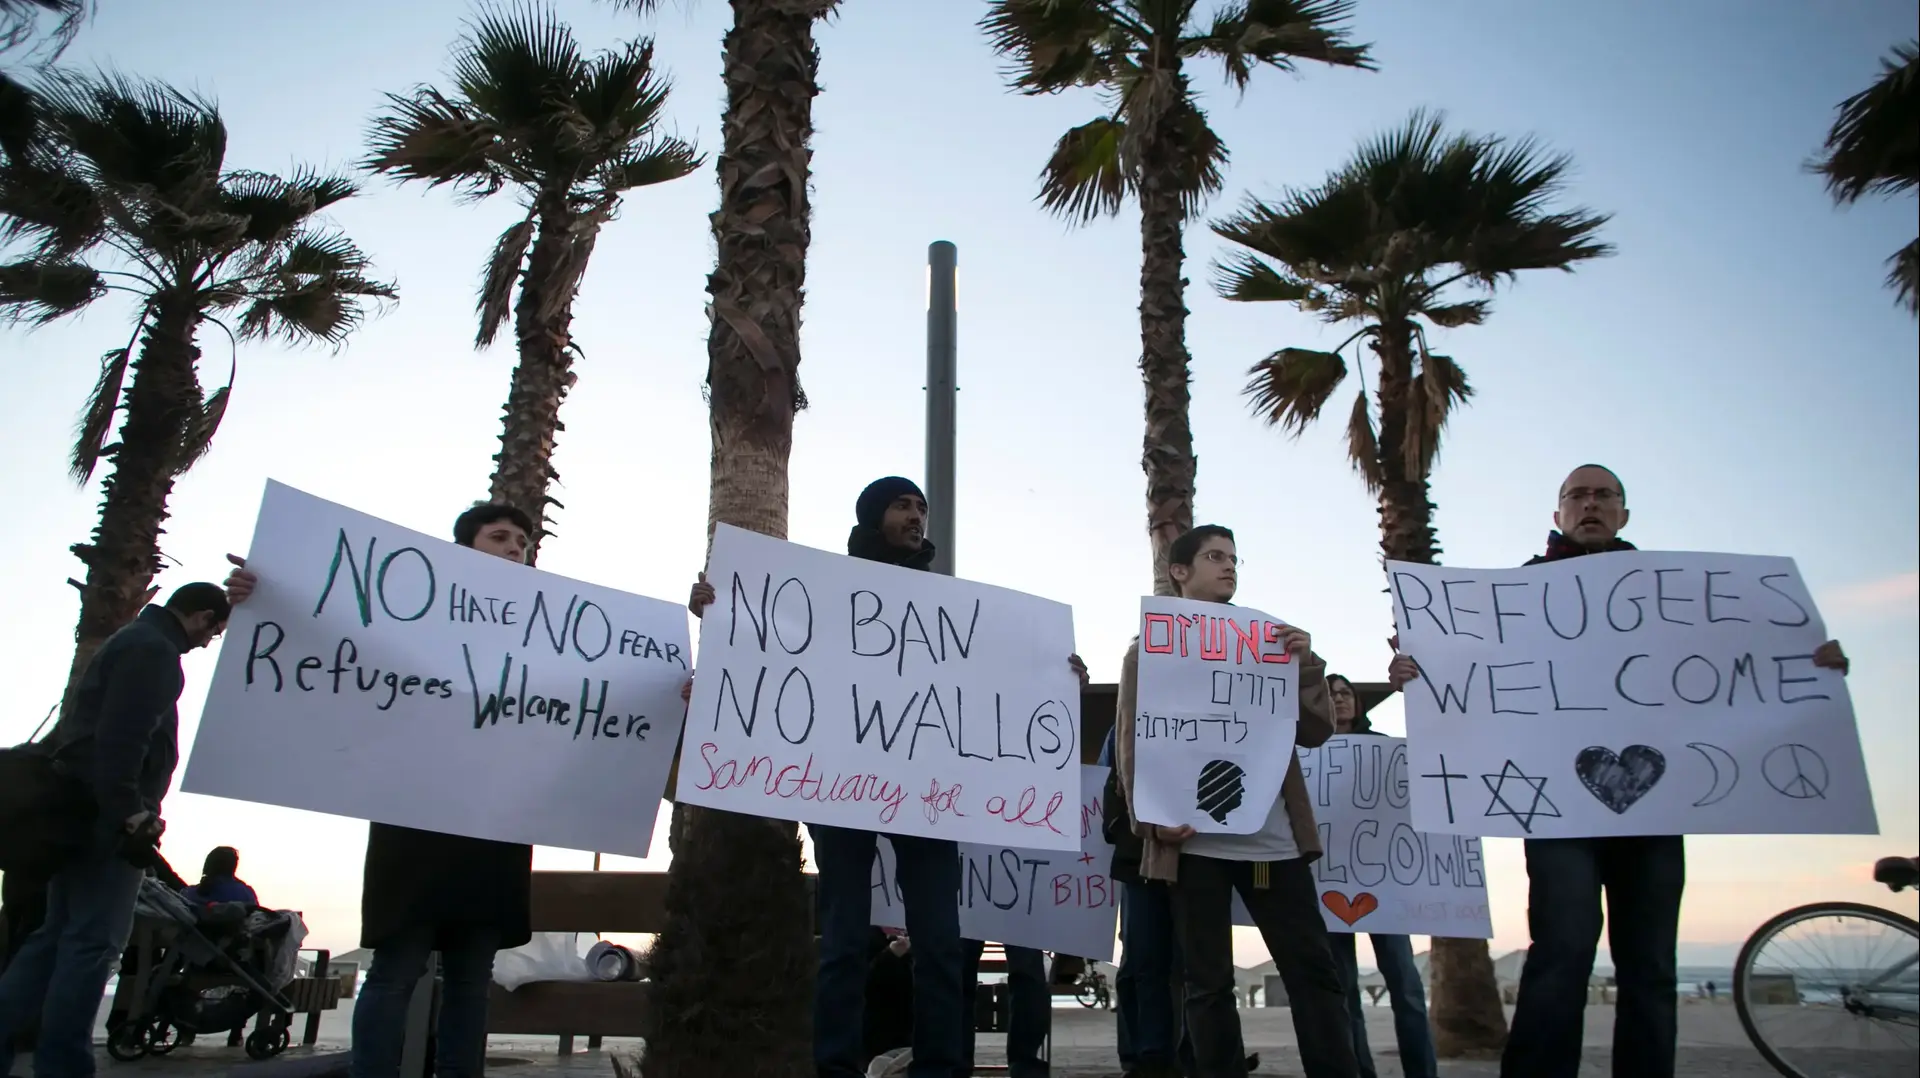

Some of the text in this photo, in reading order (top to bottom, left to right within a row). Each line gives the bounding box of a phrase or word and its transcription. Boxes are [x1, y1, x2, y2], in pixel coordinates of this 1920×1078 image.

[312, 527, 687, 671] NO HATE NO FEAR
[729, 571, 980, 677] NO BAN
[1144, 612, 1293, 666] פאשיזם
[1393, 568, 1811, 644] REFUGEES
[244, 621, 453, 711] Refugees
[572, 677, 652, 741] Here
[713, 666, 1076, 770] NO WALL(S)
[1409, 653, 1832, 716] WELCOME
[694, 742, 909, 825] Sanctuary
[921, 778, 972, 826] for
[986, 784, 1071, 838] all
[870, 848, 1116, 916] AINST BIBI
[1317, 819, 1485, 888] LCOME
